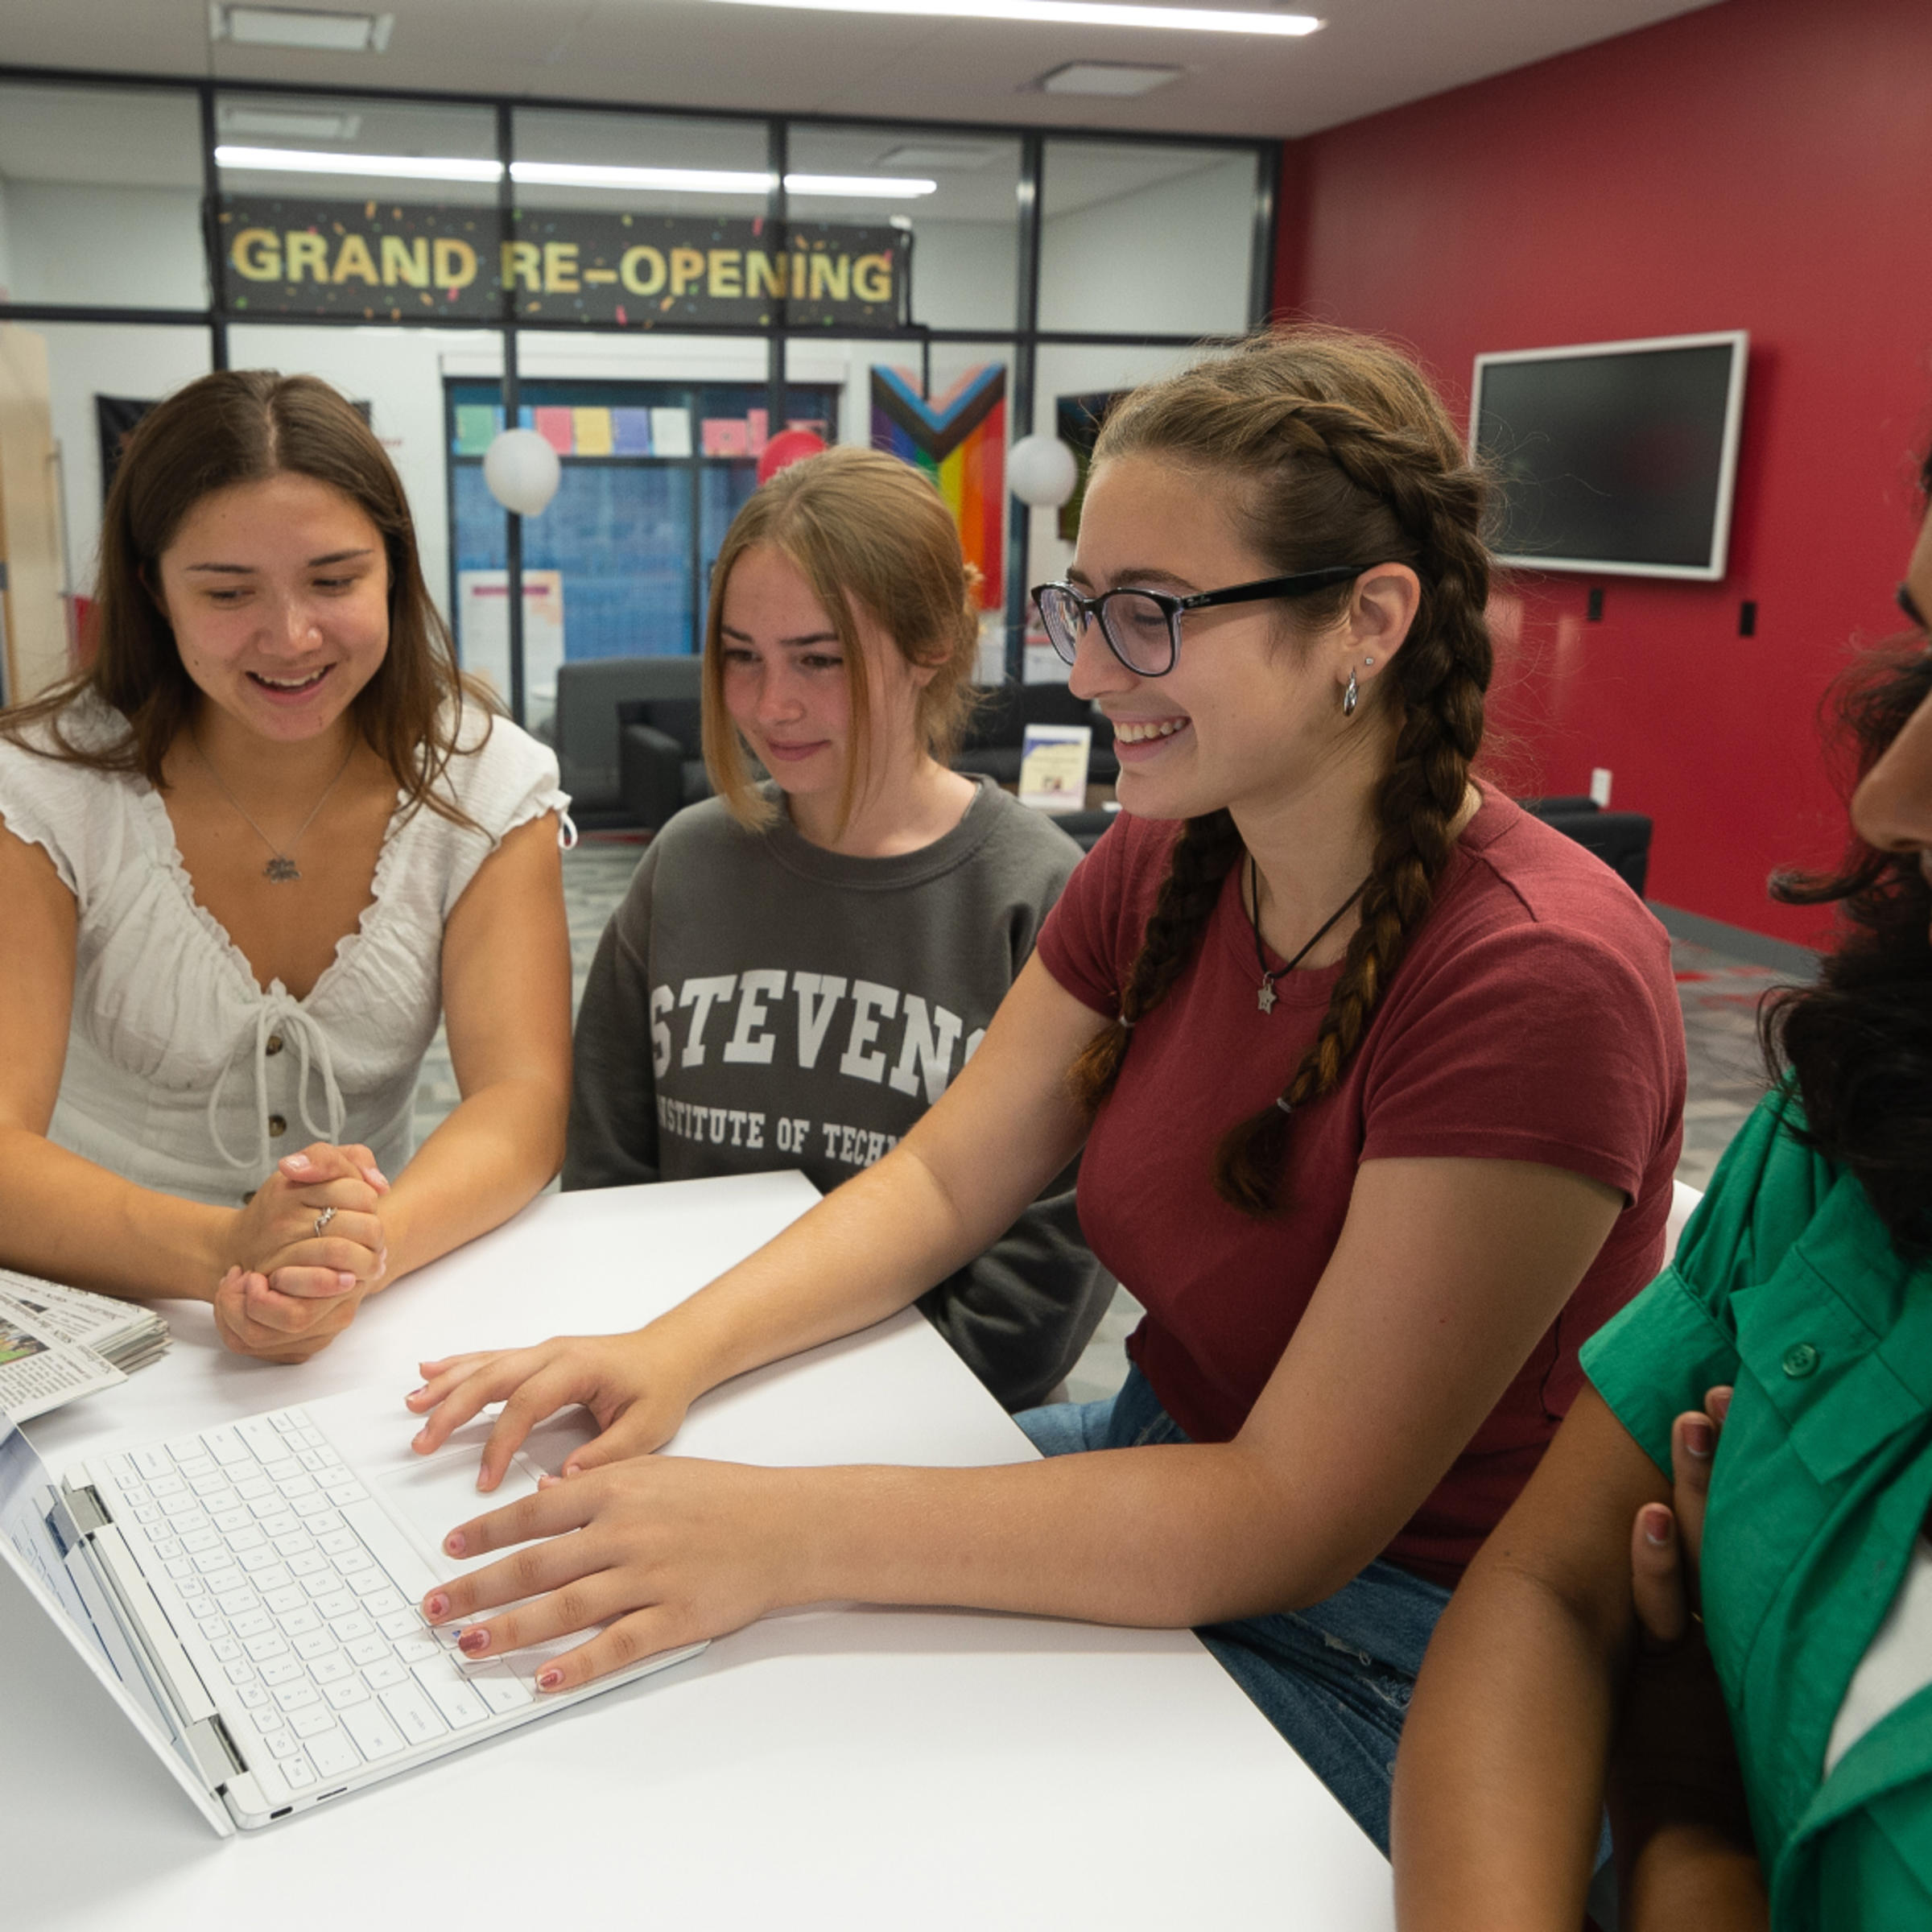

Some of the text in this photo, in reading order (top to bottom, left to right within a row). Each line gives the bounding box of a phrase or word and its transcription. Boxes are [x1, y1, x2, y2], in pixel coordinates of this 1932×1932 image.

[231, 227, 893, 303] GRAND RE-OPENING
[650, 969, 986, 1104] STEVEN
[656, 1094, 766, 1149] NSTITUTE
[777, 1117, 810, 1154] OF
